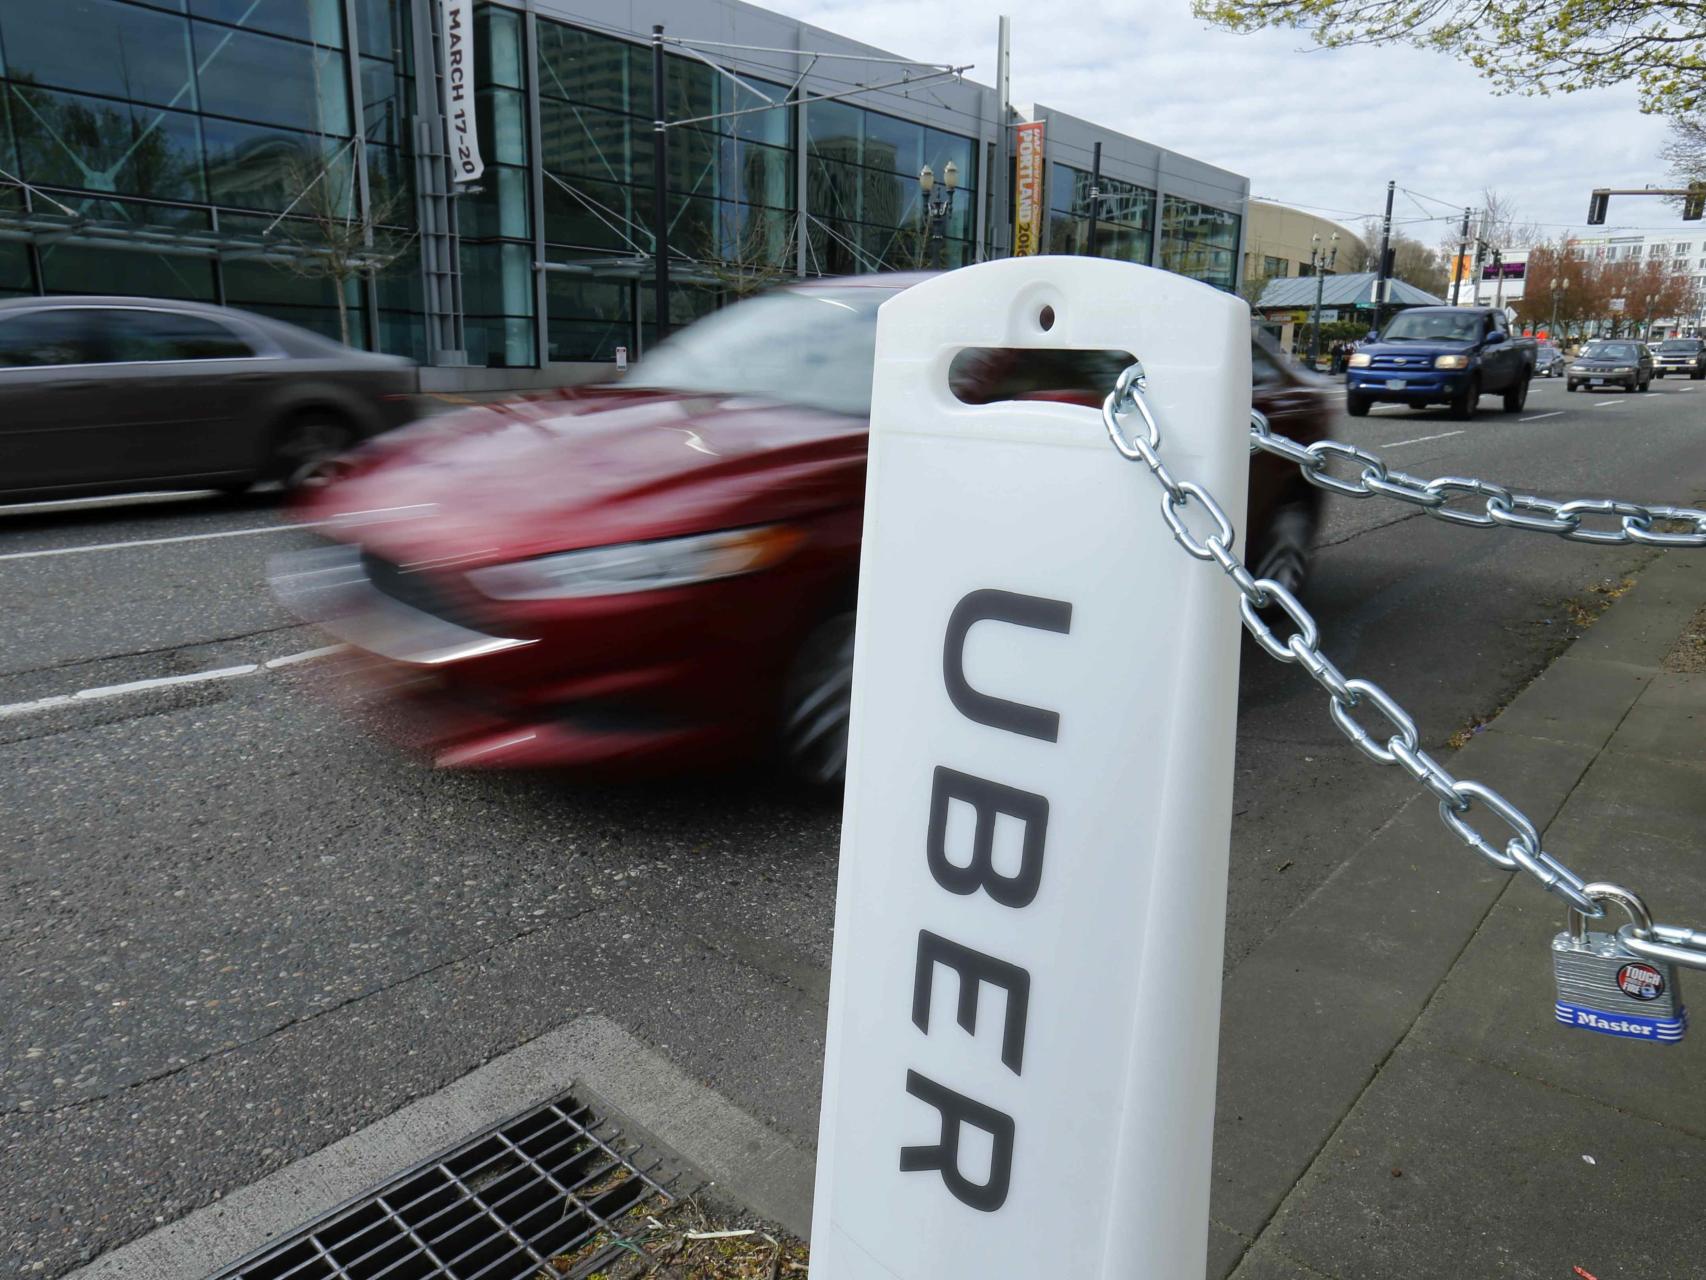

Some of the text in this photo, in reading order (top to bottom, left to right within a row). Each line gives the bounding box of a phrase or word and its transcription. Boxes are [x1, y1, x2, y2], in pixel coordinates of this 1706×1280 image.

[449, 8, 475, 174] MARCH 17-20
[1019, 129, 1033, 223] PORTLAND
[900, 588, 1072, 1212] UBER
[1626, 965, 1661, 986] TOUGH
[1577, 1012, 1652, 1036] Master
